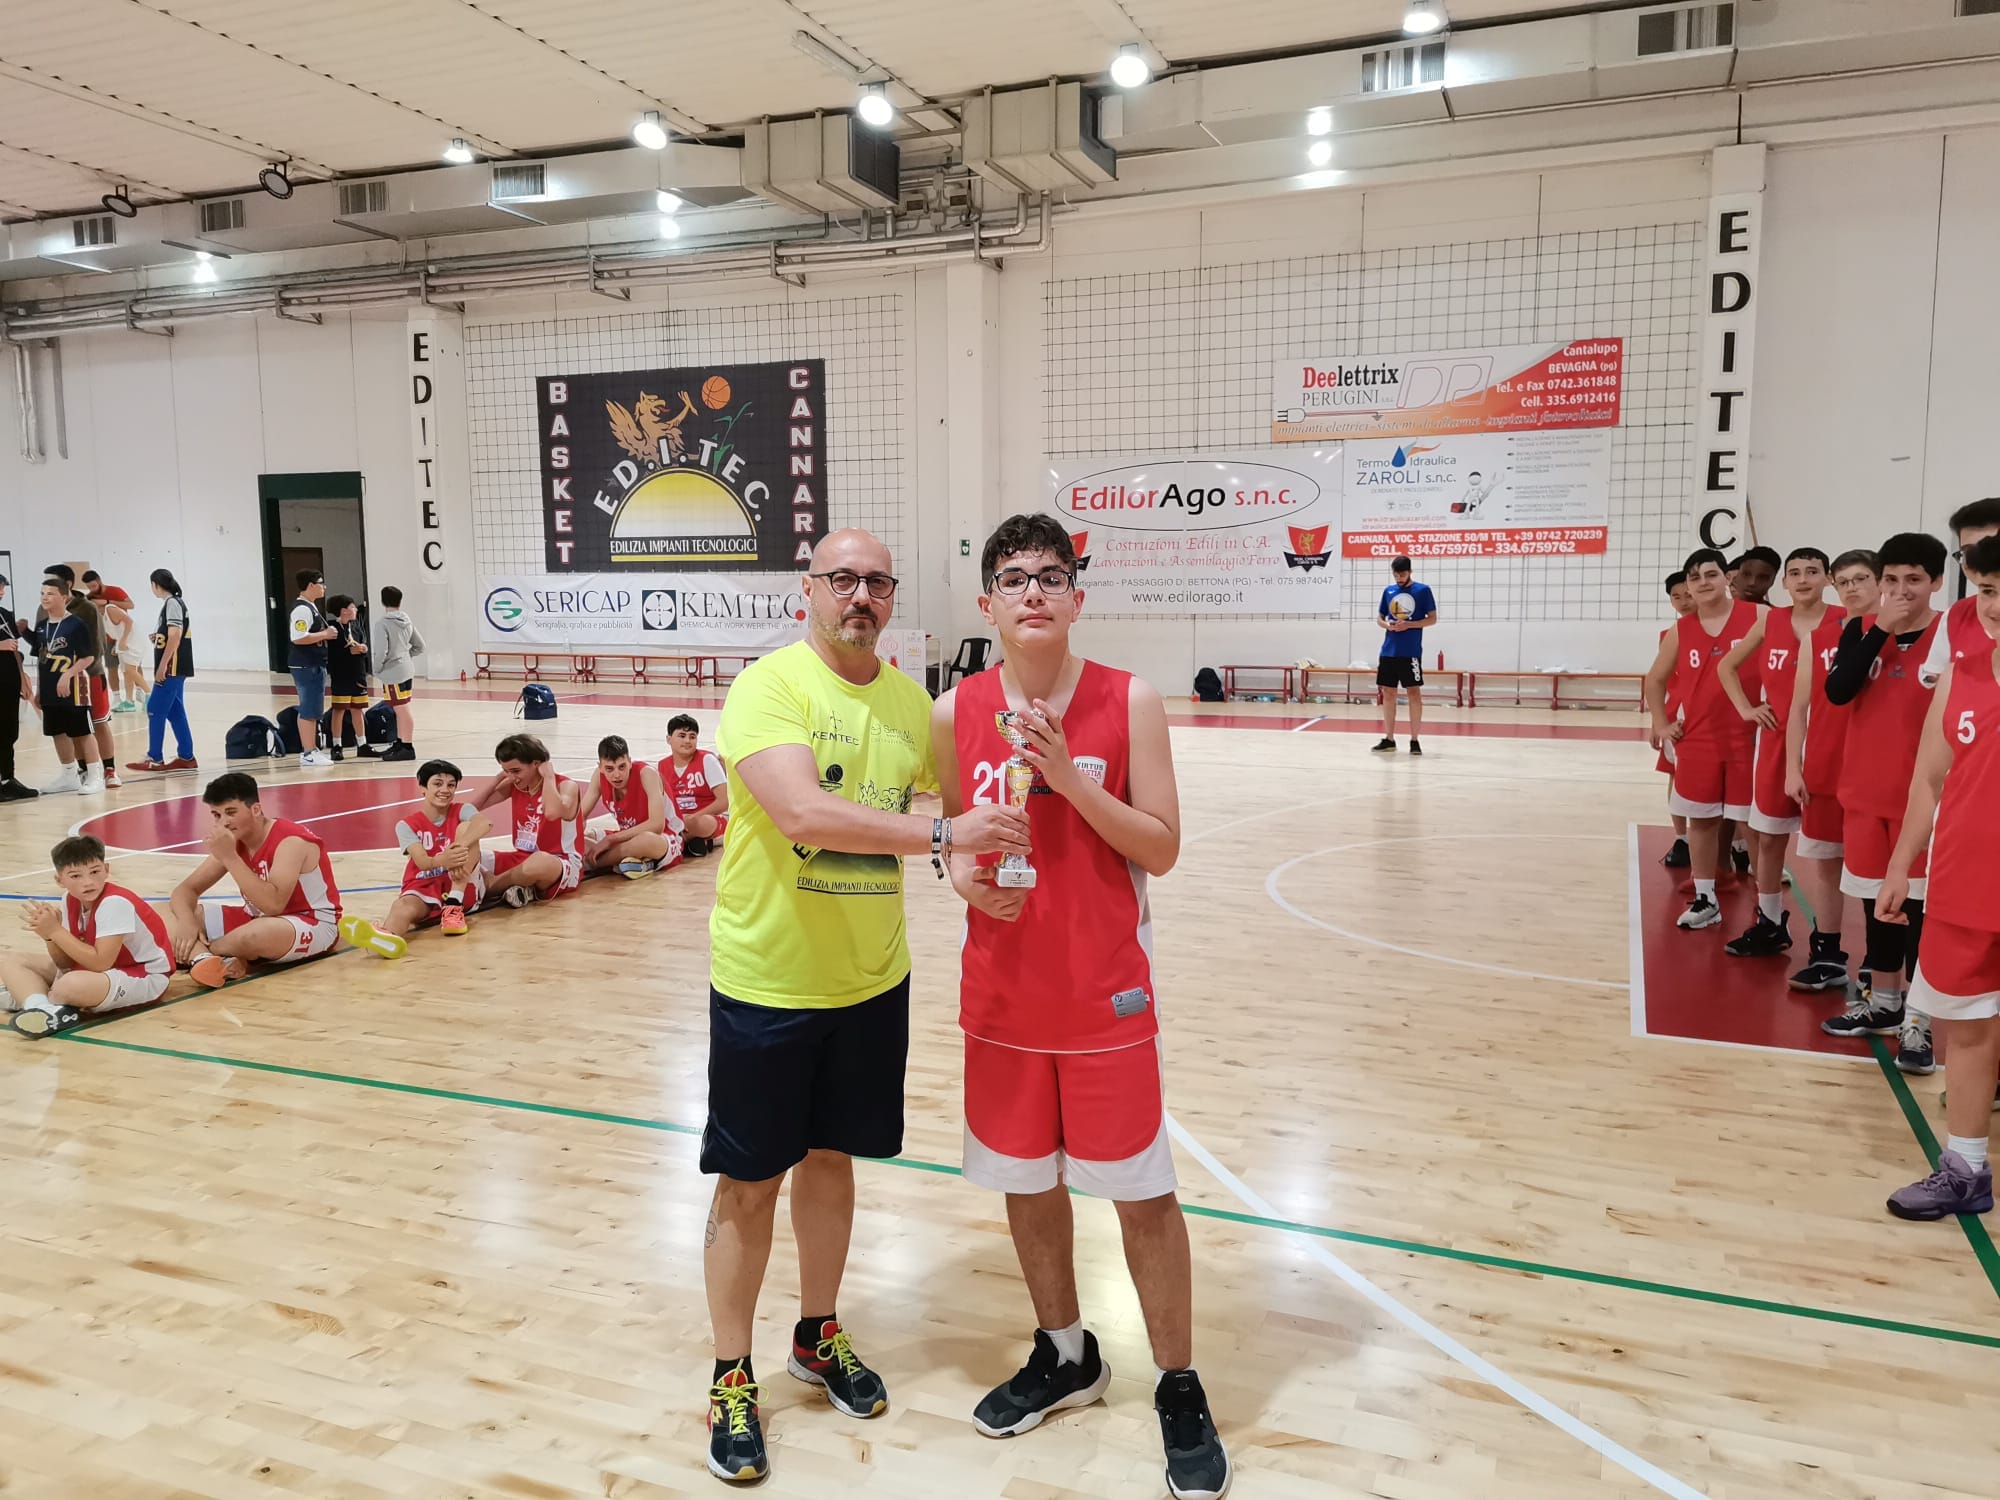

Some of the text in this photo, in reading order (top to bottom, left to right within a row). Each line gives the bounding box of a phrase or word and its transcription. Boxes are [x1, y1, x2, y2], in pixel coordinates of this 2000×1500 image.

[1563, 343, 1618, 357] Cantalupo
[1302, 362, 1399, 389] Deelettrix
[1548, 361, 1617, 374] BEVAGNA (pg)
[1496, 375, 1617, 393] Tel. e Fax 0742.361848
[1699, 210, 1752, 550] EDITEC
[1302, 389, 1379, 407] PERUGINI
[1520, 392, 1616, 407] Cell. 335.6912416
[1325, 421, 1369, 433] elettrici
[413, 332, 443, 571] EDITEC
[789, 367, 815, 562] CANNARA
[1357, 456, 1457, 468] Termo Idraulica
[549, 381, 574, 564] BASKET
[1356, 469, 1457, 485] ZAROLI s.n.c.
[1070, 483, 1297, 515] EdilorAgo s.n.c.
[609, 538, 757, 553] EDILIZIA IMPIANTI TECNOLOGICI
[1105, 534, 1271, 552] Costruzioni Edili in C.A.
[1347, 534, 1392, 545] CANNARA,
[1394, 534, 1416, 543] VOC.
[1418, 533, 1462, 543] STAZIONE
[1491, 532, 1511, 541] TEL.
[1514, 531, 1534, 541] +39
[1536, 531, 1562, 540] 0742
[1564, 530, 1603, 540] 720239
[1370, 544, 1401, 556] CELL.
[1407, 542, 1483, 556] 334.6759761
[1494, 541, 1576, 554] 334.6759762
[1093, 556, 1157, 568] Lavorazioni
[1248, 554, 1280, 567] Ferro
[1121, 578, 1174, 587] PASSAGGIO
[1187, 577, 1230, 586] BETTONA
[1232, 576, 1252, 588] (PG)
[1277, 577, 1294, 585] 075
[1296, 576, 1334, 586] 9874047
[533, 590, 631, 613] SERICAP
[679, 591, 802, 620] KEMTEC
[1131, 590, 1244, 606] www.edilorago.it
[680, 621, 714, 629] CHEMICAL
[714, 621, 724, 629] AT
[746, 622, 766, 630] WERE
[1689, 648, 1700, 669] 8
[1767, 648, 1789, 671] 57
[1957, 710, 1976, 744] 5
[1075, 761, 1104, 771] VIRTUS
[686, 771, 705, 789] 20
[973, 760, 1007, 807] 21
[797, 876, 829, 889] EDILIZIA
[831, 881, 861, 891] IMPIANTI
